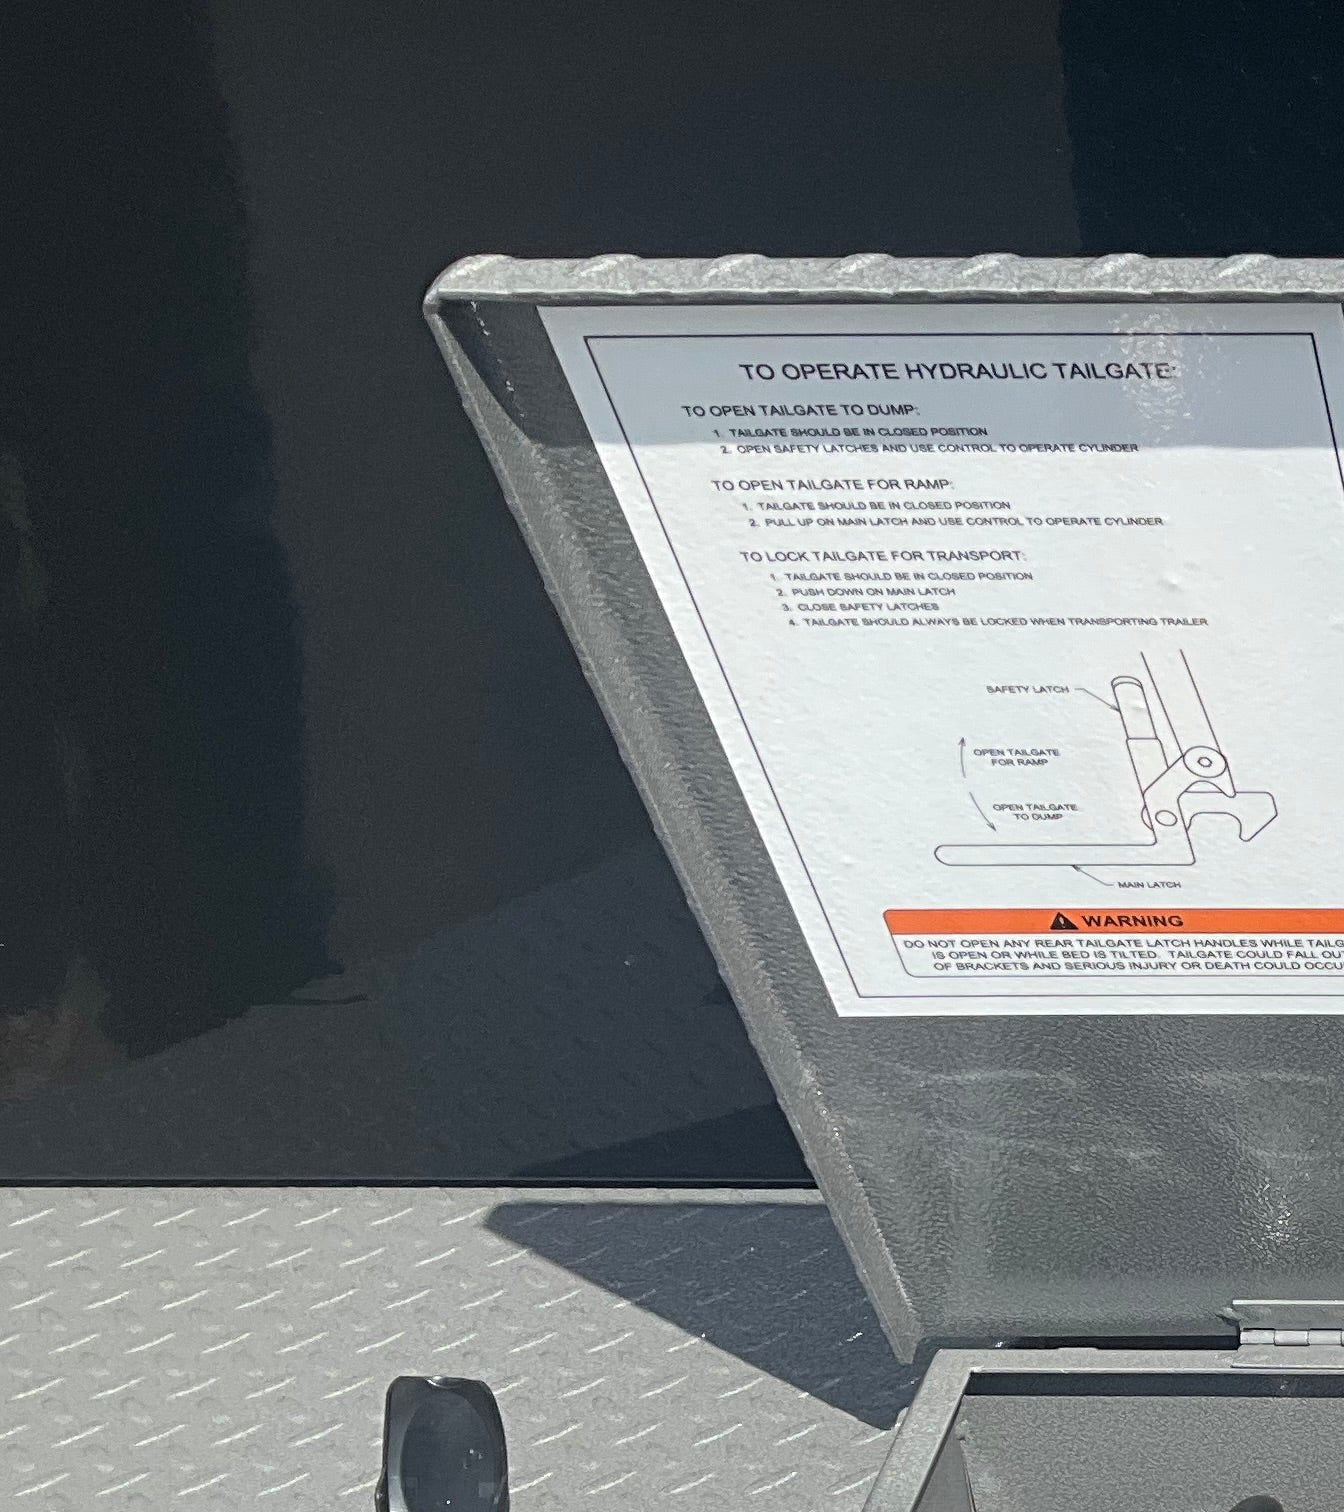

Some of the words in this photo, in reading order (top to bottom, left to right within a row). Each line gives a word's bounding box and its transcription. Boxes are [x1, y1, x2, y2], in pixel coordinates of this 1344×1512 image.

[738, 363, 775, 381] TO
[781, 362, 900, 380] OPERATE
[903, 362, 1048, 380] HYDRAULIC
[1051, 361, 1176, 380] TAILGATE:
[680, 405, 706, 417] TO
[708, 404, 756, 417] OPEN
[757, 403, 839, 416] TAILGATE
[839, 403, 864, 416] TO
[865, 403, 920, 416] DUMP:
[719, 444, 733, 454] 2.
[736, 443, 772, 454] OPEN
[773, 442, 820, 454] SAFETY
[821, 442, 879, 453] LATCHES
[879, 441, 908, 453] AND
[907, 441, 935, 453] USE
[937, 441, 998, 453] CONTROL
[996, 441, 1018, 453] TO
[1016, 441, 1078, 453] OPERATE
[1076, 441, 1141, 453] CYLINDER
[710, 479, 735, 492] TO
[737, 478, 784, 491] OPEN
[785, 478, 865, 490] TAILGATE
[866, 478, 902, 490] FOR
[903, 478, 955, 490] RAMP:
[739, 550, 763, 562] TO
[764, 550, 810, 562] LOCK
[810, 549, 889, 562] TAILGATE
[889, 549, 925, 561] FOR
[925, 549, 1027, 562] TRANSPORT:
[985, 684, 1030, 694] SAFETY
[1031, 684, 1070, 694] LATCH
[972, 748, 1006, 757] OPEN
[1006, 747, 1060, 757] TAILGATE
[990, 758, 1016, 766] FOR
[1016, 757, 1049, 766] RAMP
[991, 802, 1024, 812] OPEN
[1024, 802, 1078, 812] TAILGATE
[1012, 812, 1030, 821] TO
[1030, 812, 1064, 821] DUMP
[1116, 881, 1145, 889] MAIN
[1146, 880, 1182, 889] LATCH
[1080, 914, 1184, 927] WARNING
[902, 939, 925, 949] DO
[926, 939, 956, 949] NOT
[959, 938, 1000, 948] OPEN
[1003, 939, 1030, 948] ANY
[1033, 938, 1074, 948] REAR
[1075, 938, 1143, 948] TAILGATE
[1145, 938, 1191, 948] LATCH
[1192, 938, 1259, 948] HANDLES
[1259, 938, 1304, 948] WHILE
[931, 950, 946, 960] IS
[947, 950, 988, 960] OPEN
[989, 950, 1013, 959] OR
[1013, 950, 1059, 959] WHILE
[1060, 950, 1090, 959] BED
[1092, 949, 1107, 959] IS
[1108, 949, 1162, 959] TILTED.
[1167, 949, 1233, 959] TAILGATE
[1235, 949, 1283, 959] COULD
[1285, 949, 1319, 959] FALL
[932, 961, 951, 971] OF
[955, 961, 1030, 971] BRACKETS
[1032, 961, 1062, 970] AND
[1063, 960, 1126, 971] SERIOUS
[1127, 961, 1177, 970] INJURY
[1180, 960, 1202, 970] OR
[1203, 960, 1251, 970] DEATH
[1253, 960, 1301, 970] COULD
